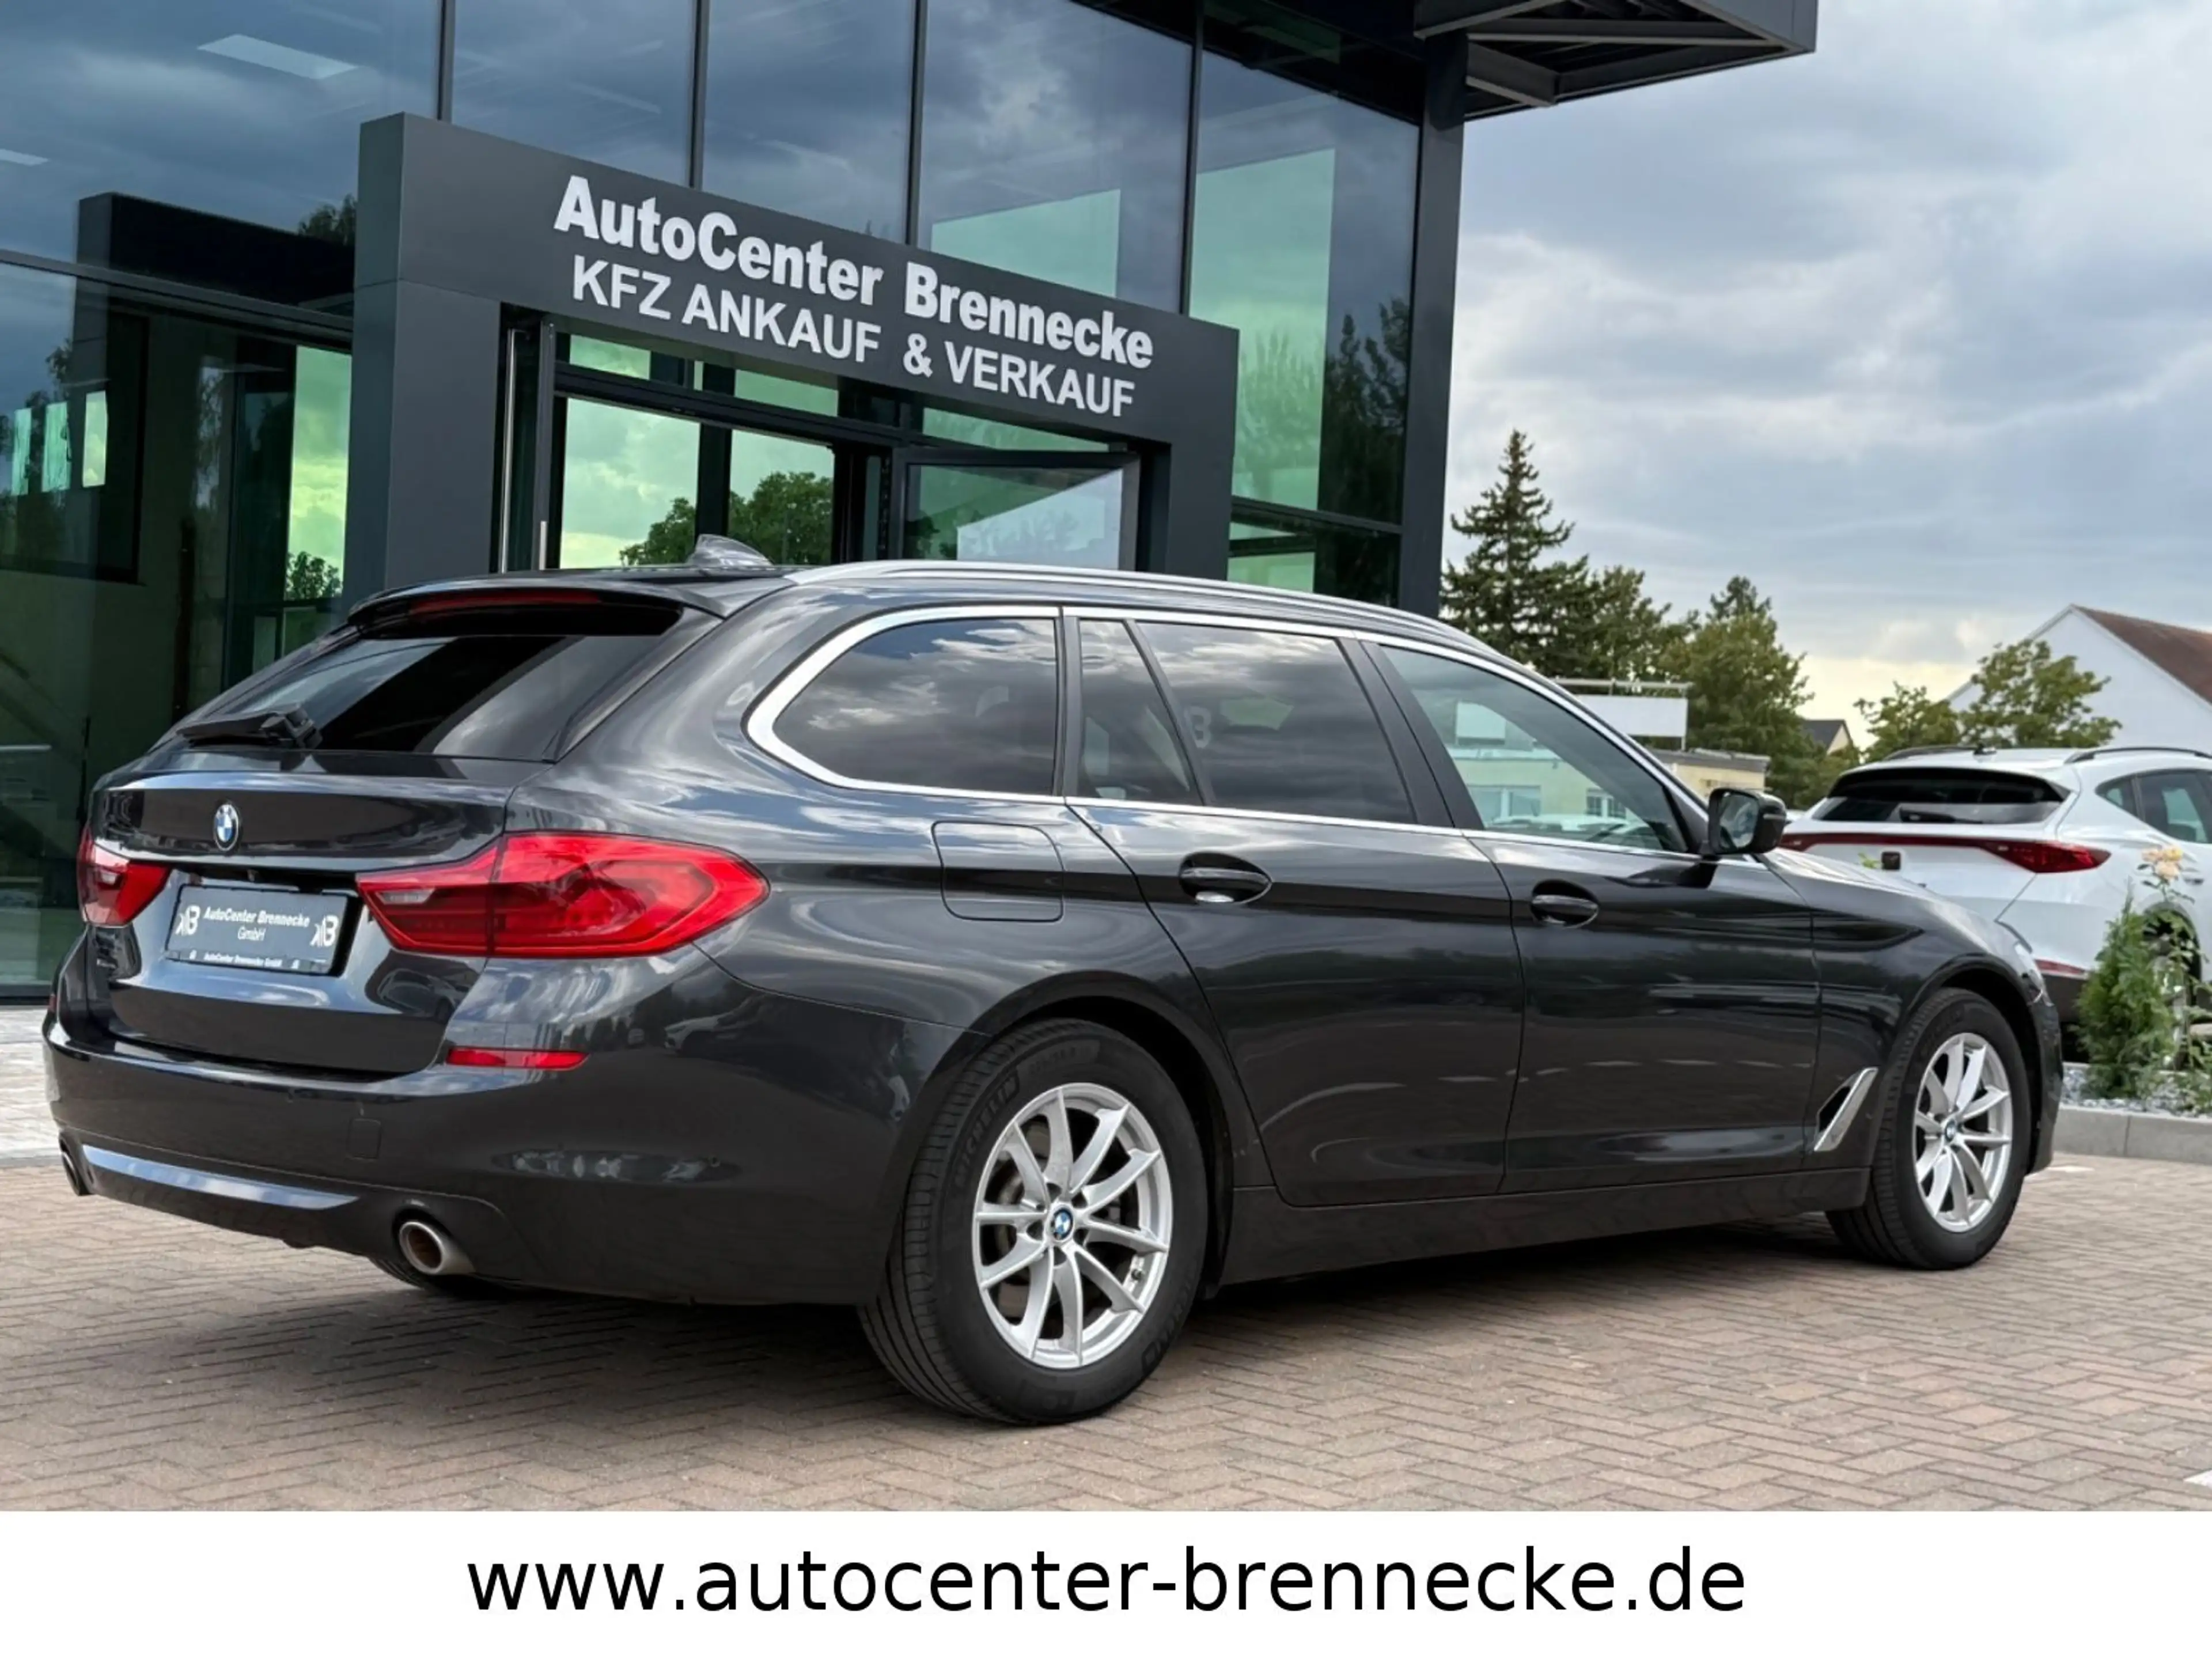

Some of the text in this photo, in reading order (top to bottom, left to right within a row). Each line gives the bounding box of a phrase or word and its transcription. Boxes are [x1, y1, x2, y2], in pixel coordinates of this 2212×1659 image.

[554, 176, 1152, 368] AutoCenter Brennecke
[574, 255, 1135, 416] KFZ ANKAUF & VERKAUF
[203, 906, 310, 927] AutoCenter Brennecke
[237, 926, 267, 941] GmbH
